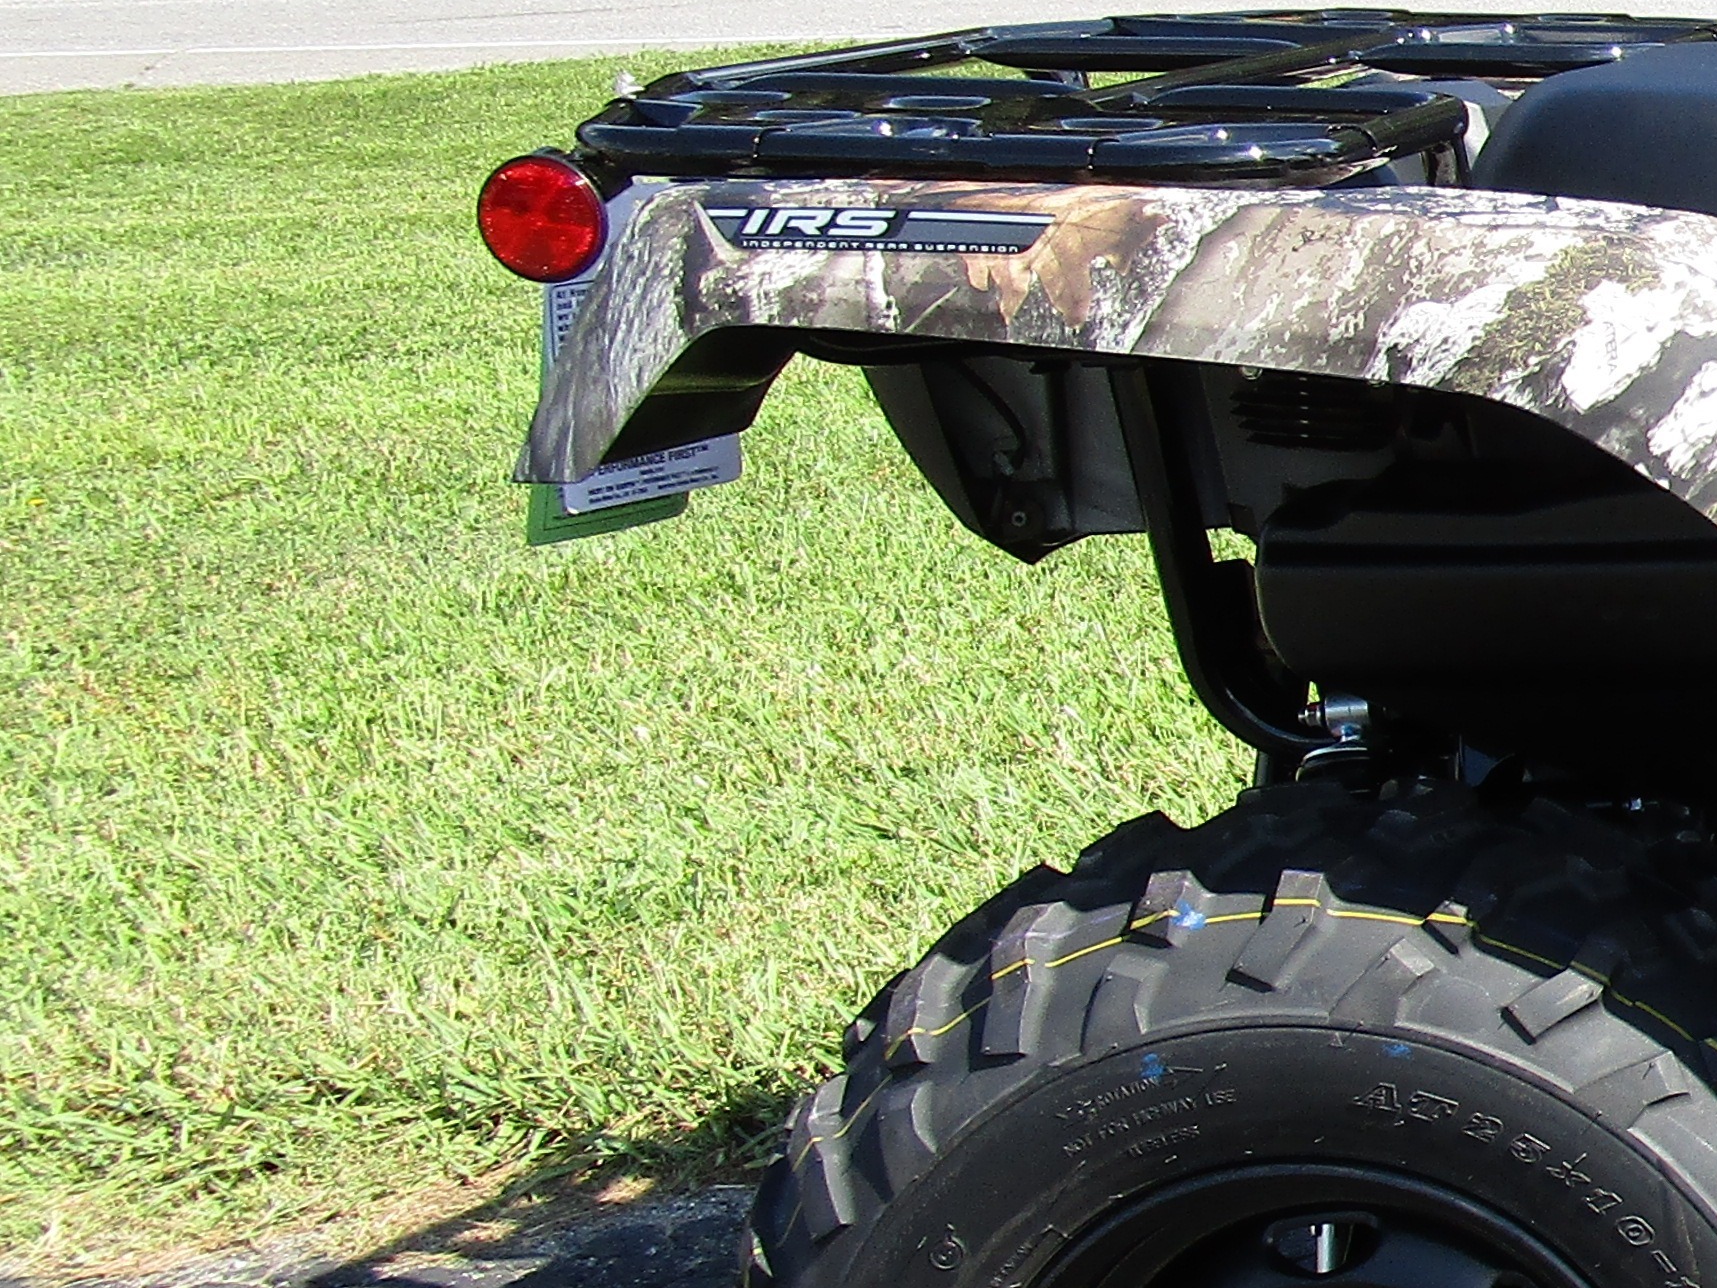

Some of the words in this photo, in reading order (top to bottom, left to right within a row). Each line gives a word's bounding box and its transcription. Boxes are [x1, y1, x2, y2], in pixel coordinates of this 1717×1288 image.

[741, 208, 897, 238] IRS
[743, 239, 860, 249] INDEPENDENT
[865, 241, 908, 250] REAR
[914, 243, 1019, 253] SUSPENSION
